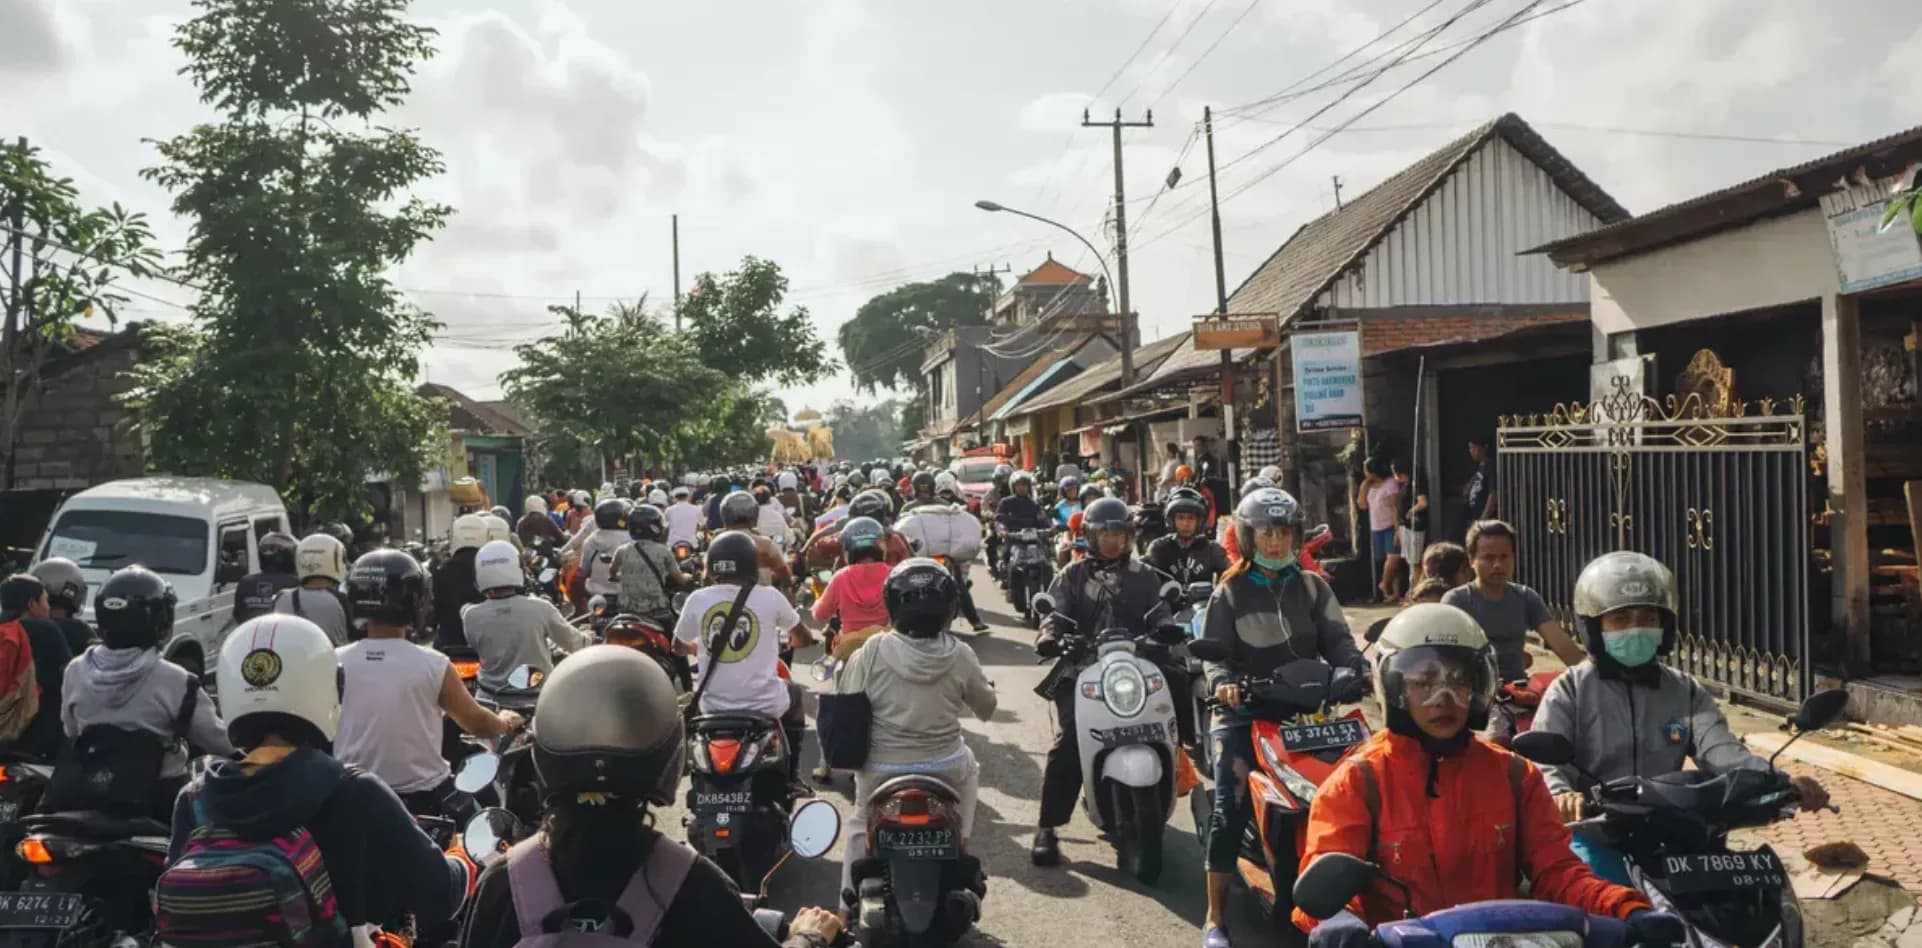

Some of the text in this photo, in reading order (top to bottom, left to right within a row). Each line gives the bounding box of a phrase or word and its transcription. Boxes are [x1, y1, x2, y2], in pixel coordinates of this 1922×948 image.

[1666, 854, 1774, 874] DK 7869 KY
[16, 896, 50, 910] 6274
